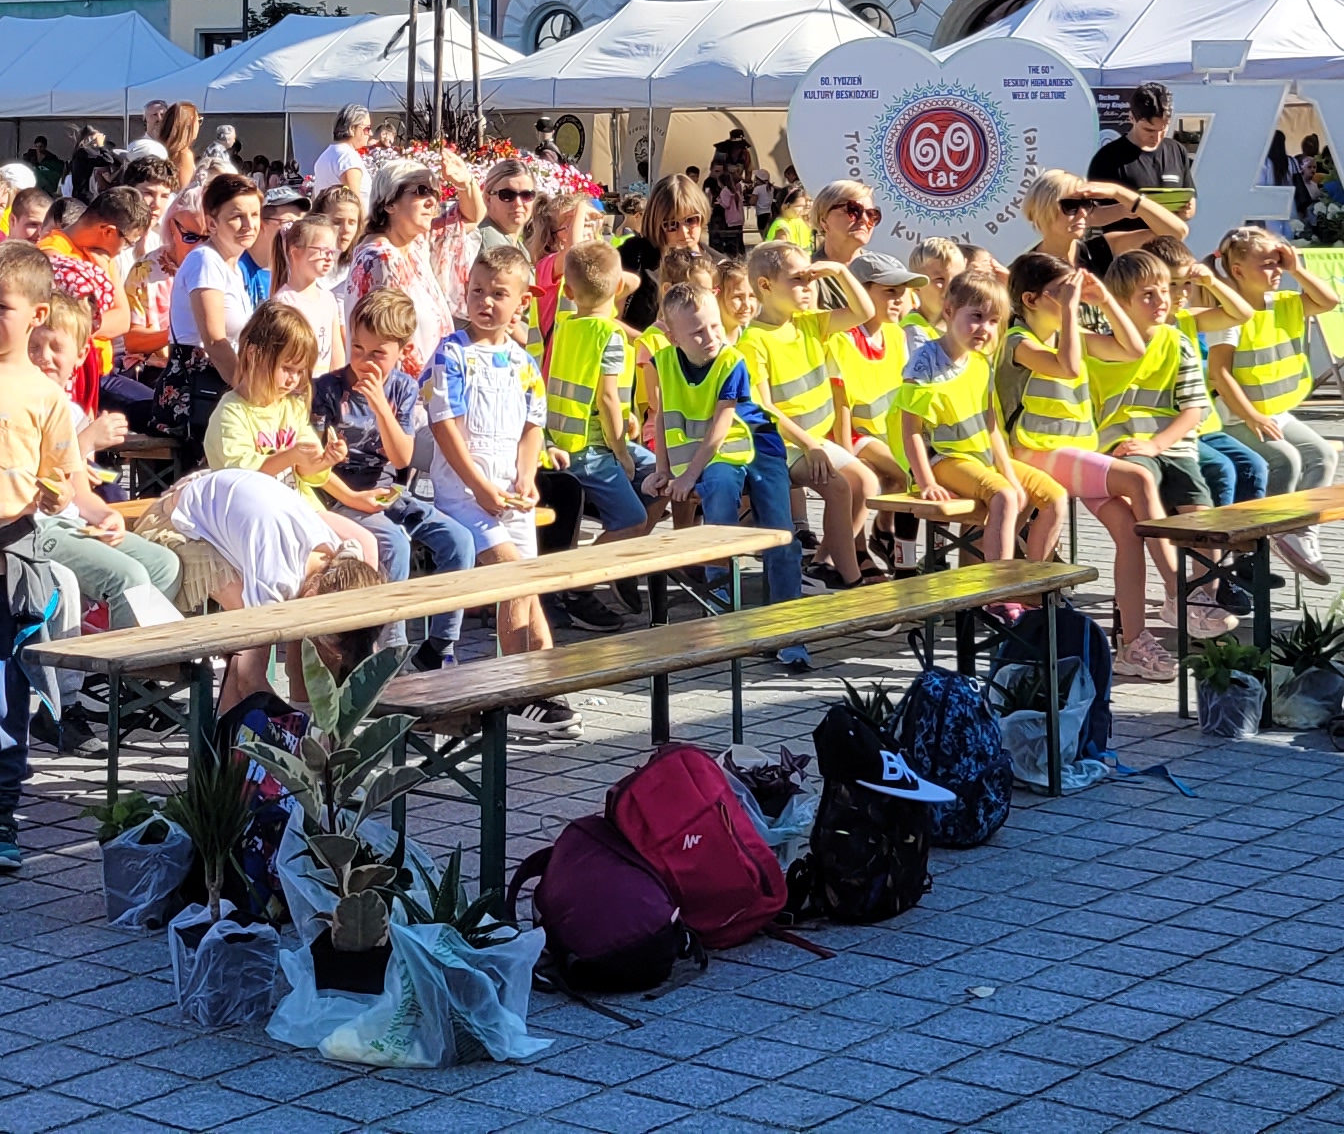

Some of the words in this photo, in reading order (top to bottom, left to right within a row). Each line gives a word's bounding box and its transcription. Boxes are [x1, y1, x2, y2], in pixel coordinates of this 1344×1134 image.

[1028, 65, 1041, 74] THE
[820, 76, 832, 86] 60.
[833, 75, 862, 86] TYDZIEŃ
[1003, 78, 1029, 87] BESKIDY
[804, 90, 834, 99] KULTURY
[836, 90, 879, 99] BESKIDZKIEJ
[1011, 91, 1029, 100] WEEK
[1031, 91, 1038, 100] OF
[1040, 91, 1067, 100] CULTURE
[910, 122, 975, 172] 60
[844, 131, 864, 182] TYGO
[928, 171, 958, 188] lat
